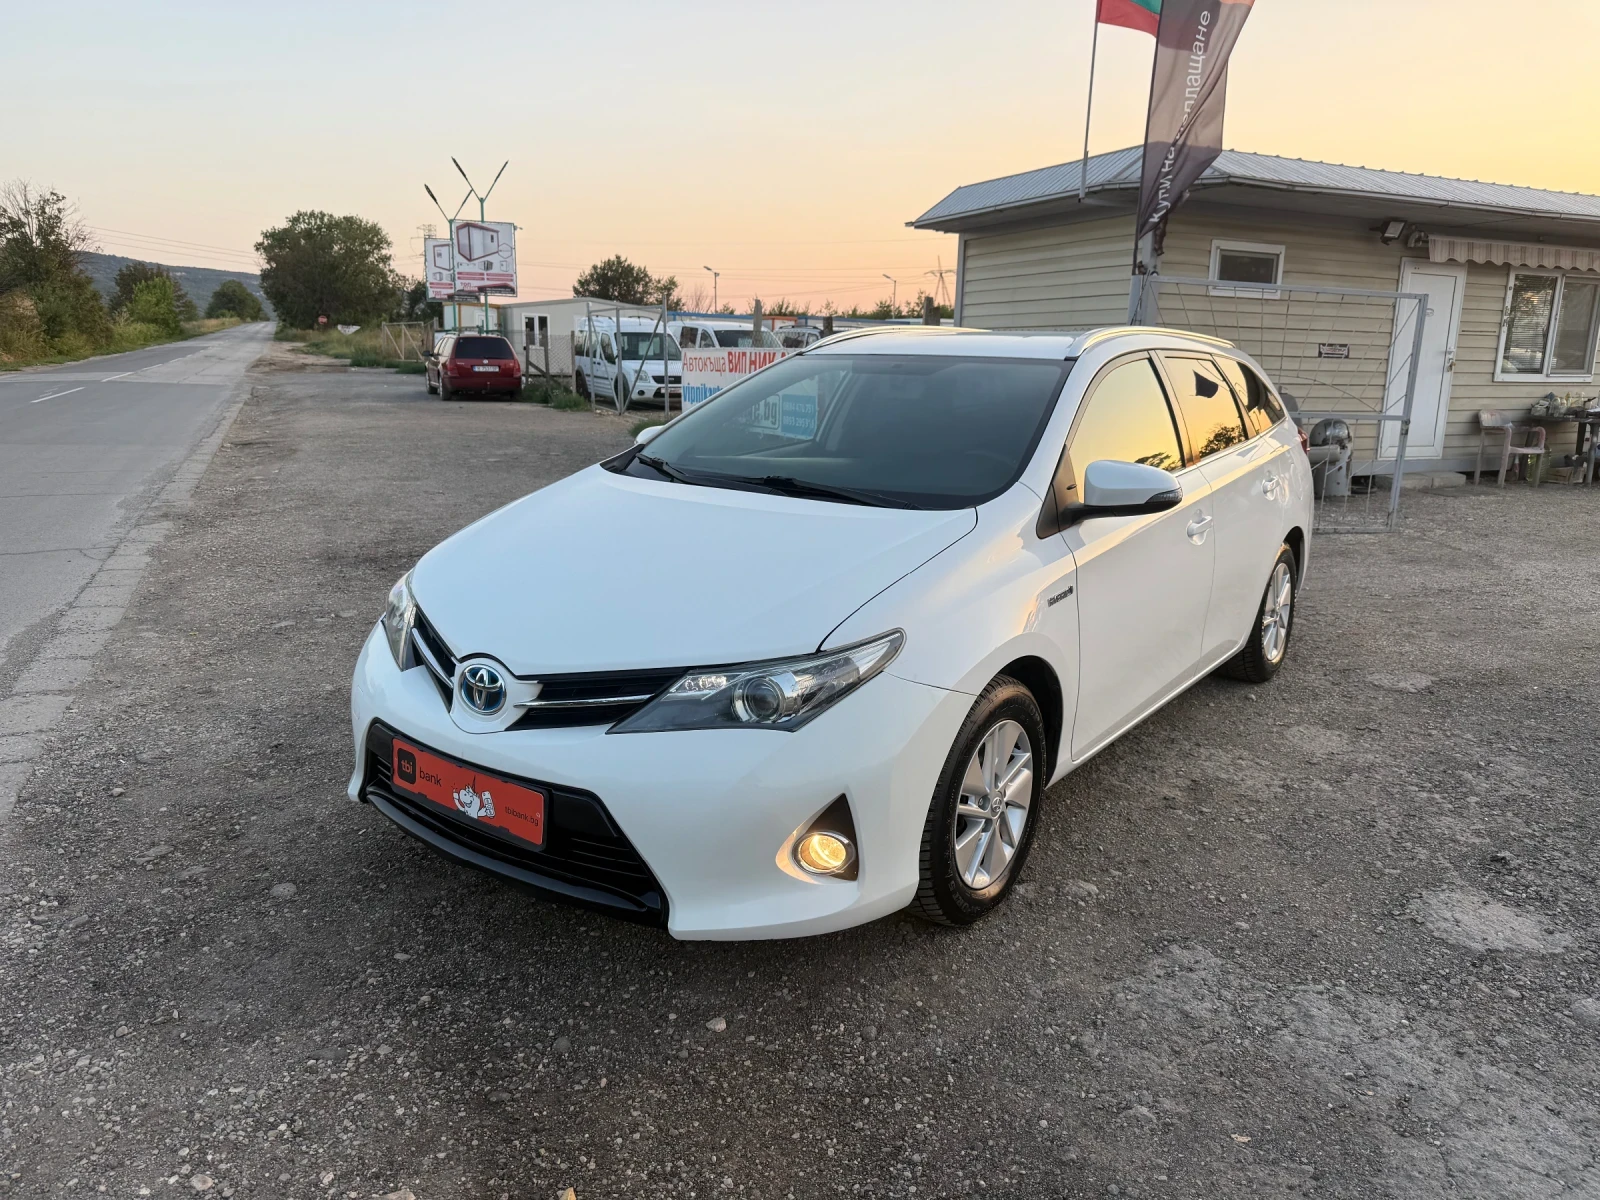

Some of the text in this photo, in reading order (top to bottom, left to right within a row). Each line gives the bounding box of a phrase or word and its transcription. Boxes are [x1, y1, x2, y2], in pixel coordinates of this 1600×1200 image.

[1149, 175, 1173, 222] Купи
[682, 351, 777, 376] Автокъща ВИП НИК
[400, 759, 442, 788] tbi bank
[504, 805, 539, 827] tbibank.bg
